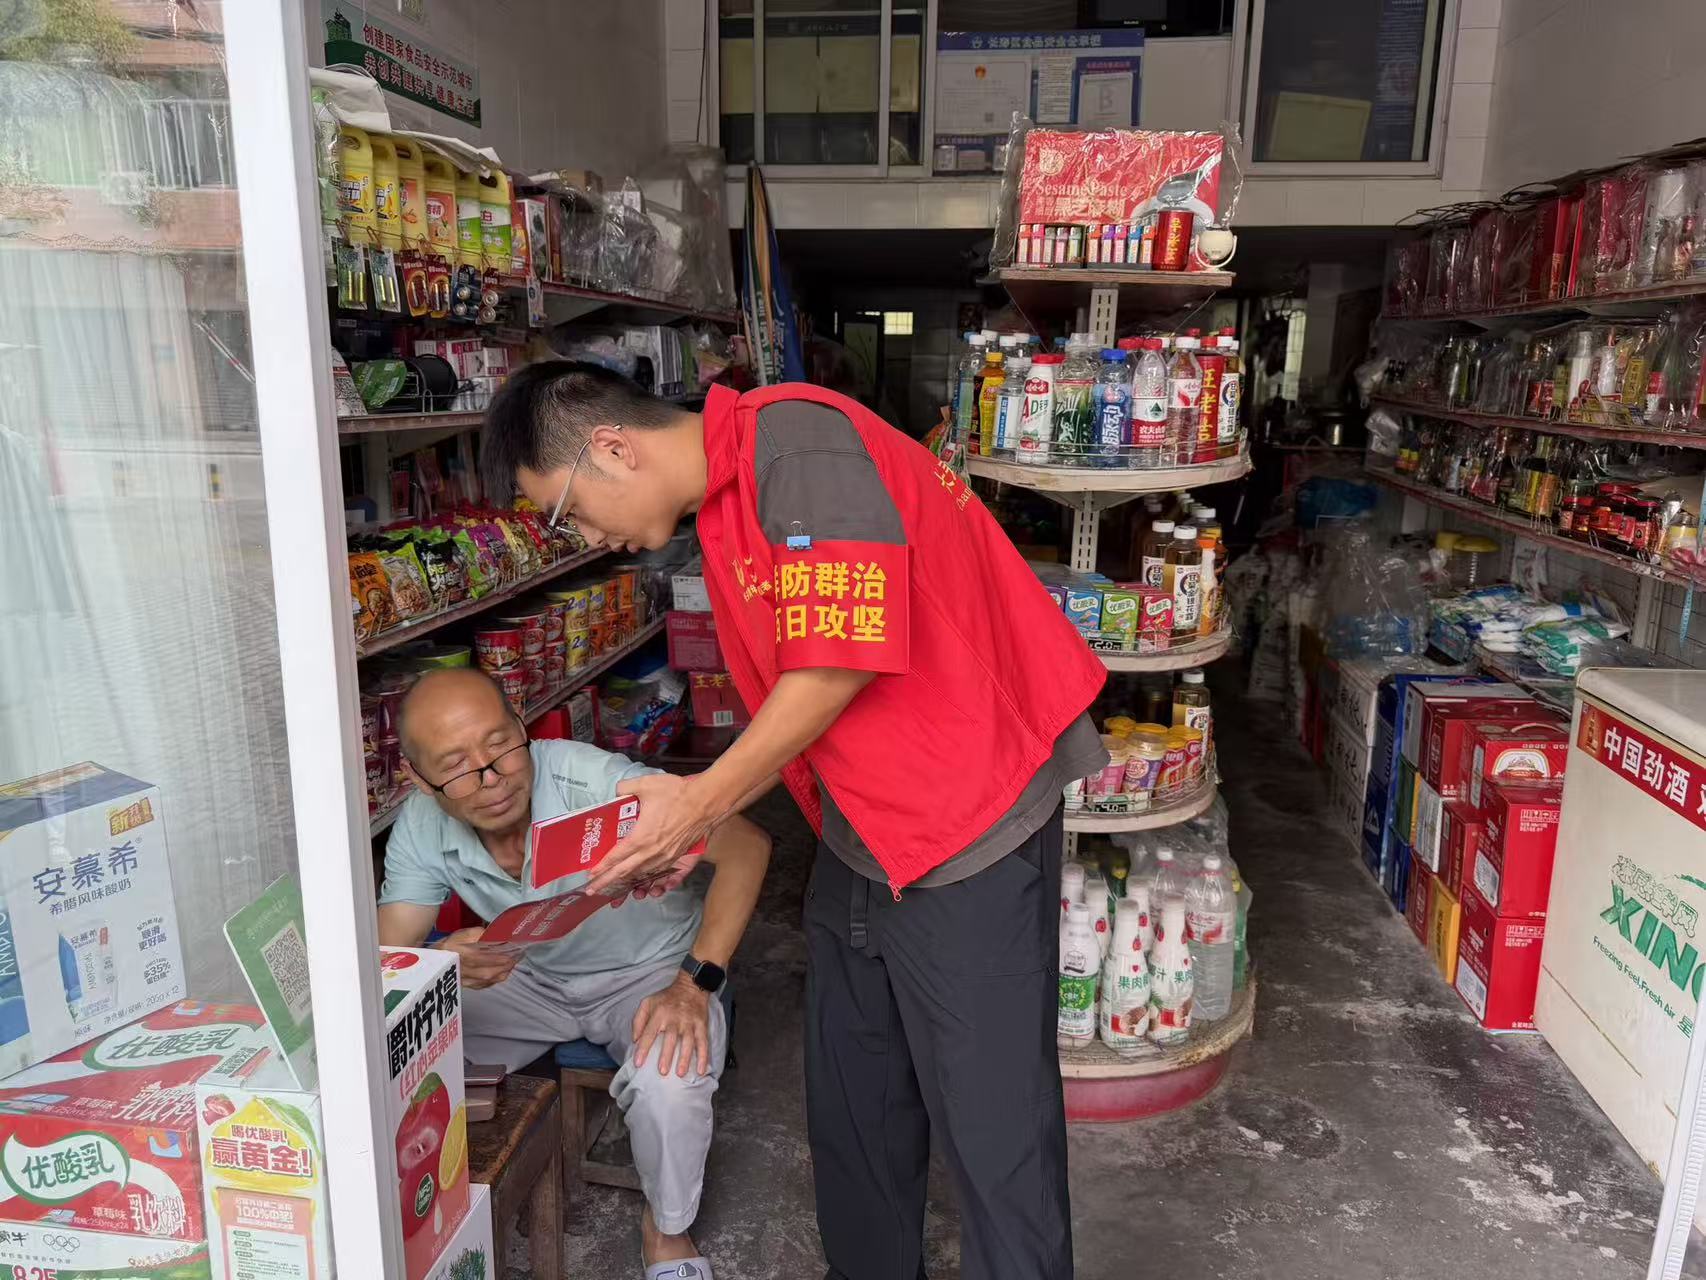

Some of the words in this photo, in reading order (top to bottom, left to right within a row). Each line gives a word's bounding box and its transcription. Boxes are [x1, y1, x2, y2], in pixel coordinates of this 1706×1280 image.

[363, 23, 473, 91] 创建国家食品安全示范城市
[1036, 181, 1087, 196] Sesame
[1091, 179, 1127, 197] Paste
[774, 560, 887, 602] 防群治
[775, 603, 886, 643] 日攻坚
[1604, 726, 1691, 807] 中国劲酒
[33, 839, 138, 904] 安慕希
[49, 877, 132, 916] 希腊风味酸奶
[1593, 935, 1623, 971] Freezing
[106, 1025, 240, 1061] 优酸乳
[21, 1140, 116, 1190] 优酸乳
[211, 1137, 312, 1175] 赢黄金!
[127, 1193, 187, 1236] 乳饮料
